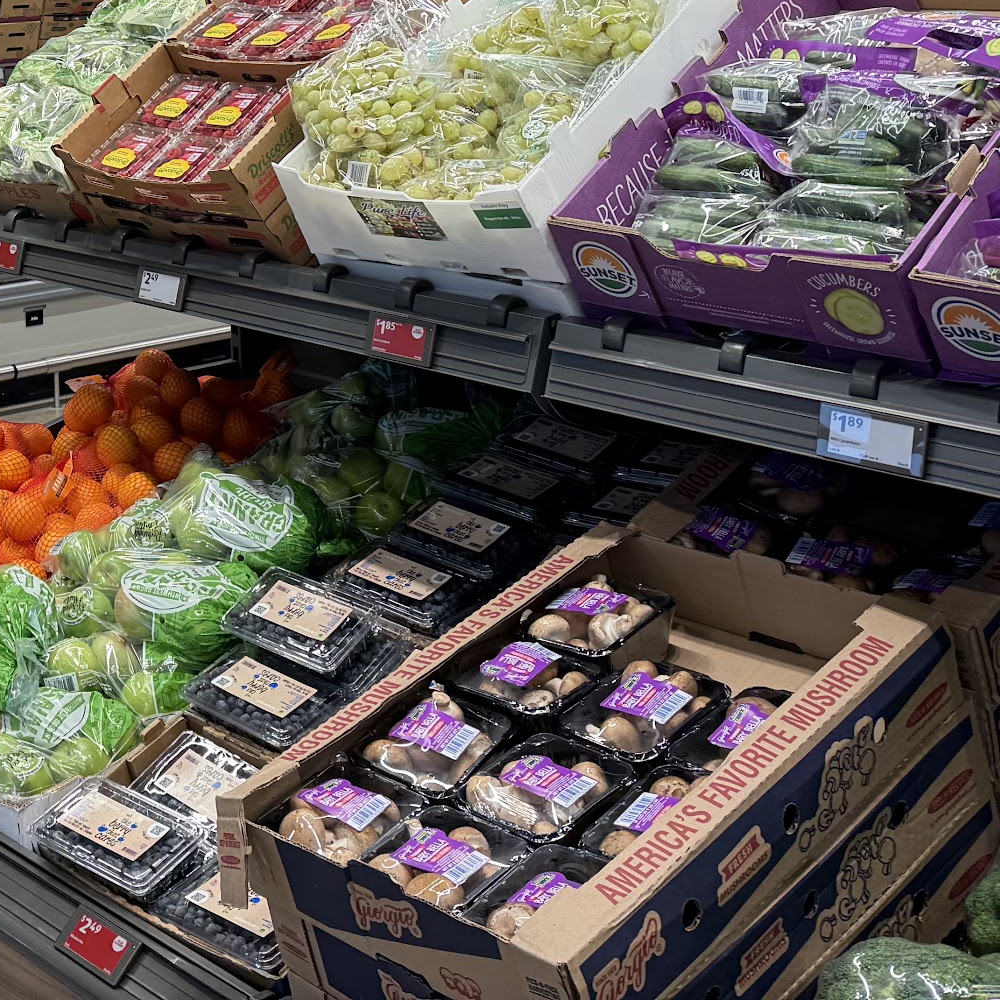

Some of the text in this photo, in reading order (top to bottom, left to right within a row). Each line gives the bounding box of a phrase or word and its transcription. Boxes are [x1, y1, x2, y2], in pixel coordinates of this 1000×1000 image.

[247, 123, 296, 180] Driscoll's
[580, 265, 637, 289] SUNSET
[806, 272, 881, 298] CUCUMBERS
[279, 554, 575, 762] AMERICA'S FAVORITE MUSHROOM
[594, 803, 713, 905] AMERICA'S
[697, 724, 798, 809] FAVORITE
[779, 635, 895, 735] MUSHROOM
[94, 833, 118, 847] cares
[108, 818, 132, 836] berry
[727, 842, 752, 874] FRESH
[719, 849, 769, 903] MUSHROOMS
